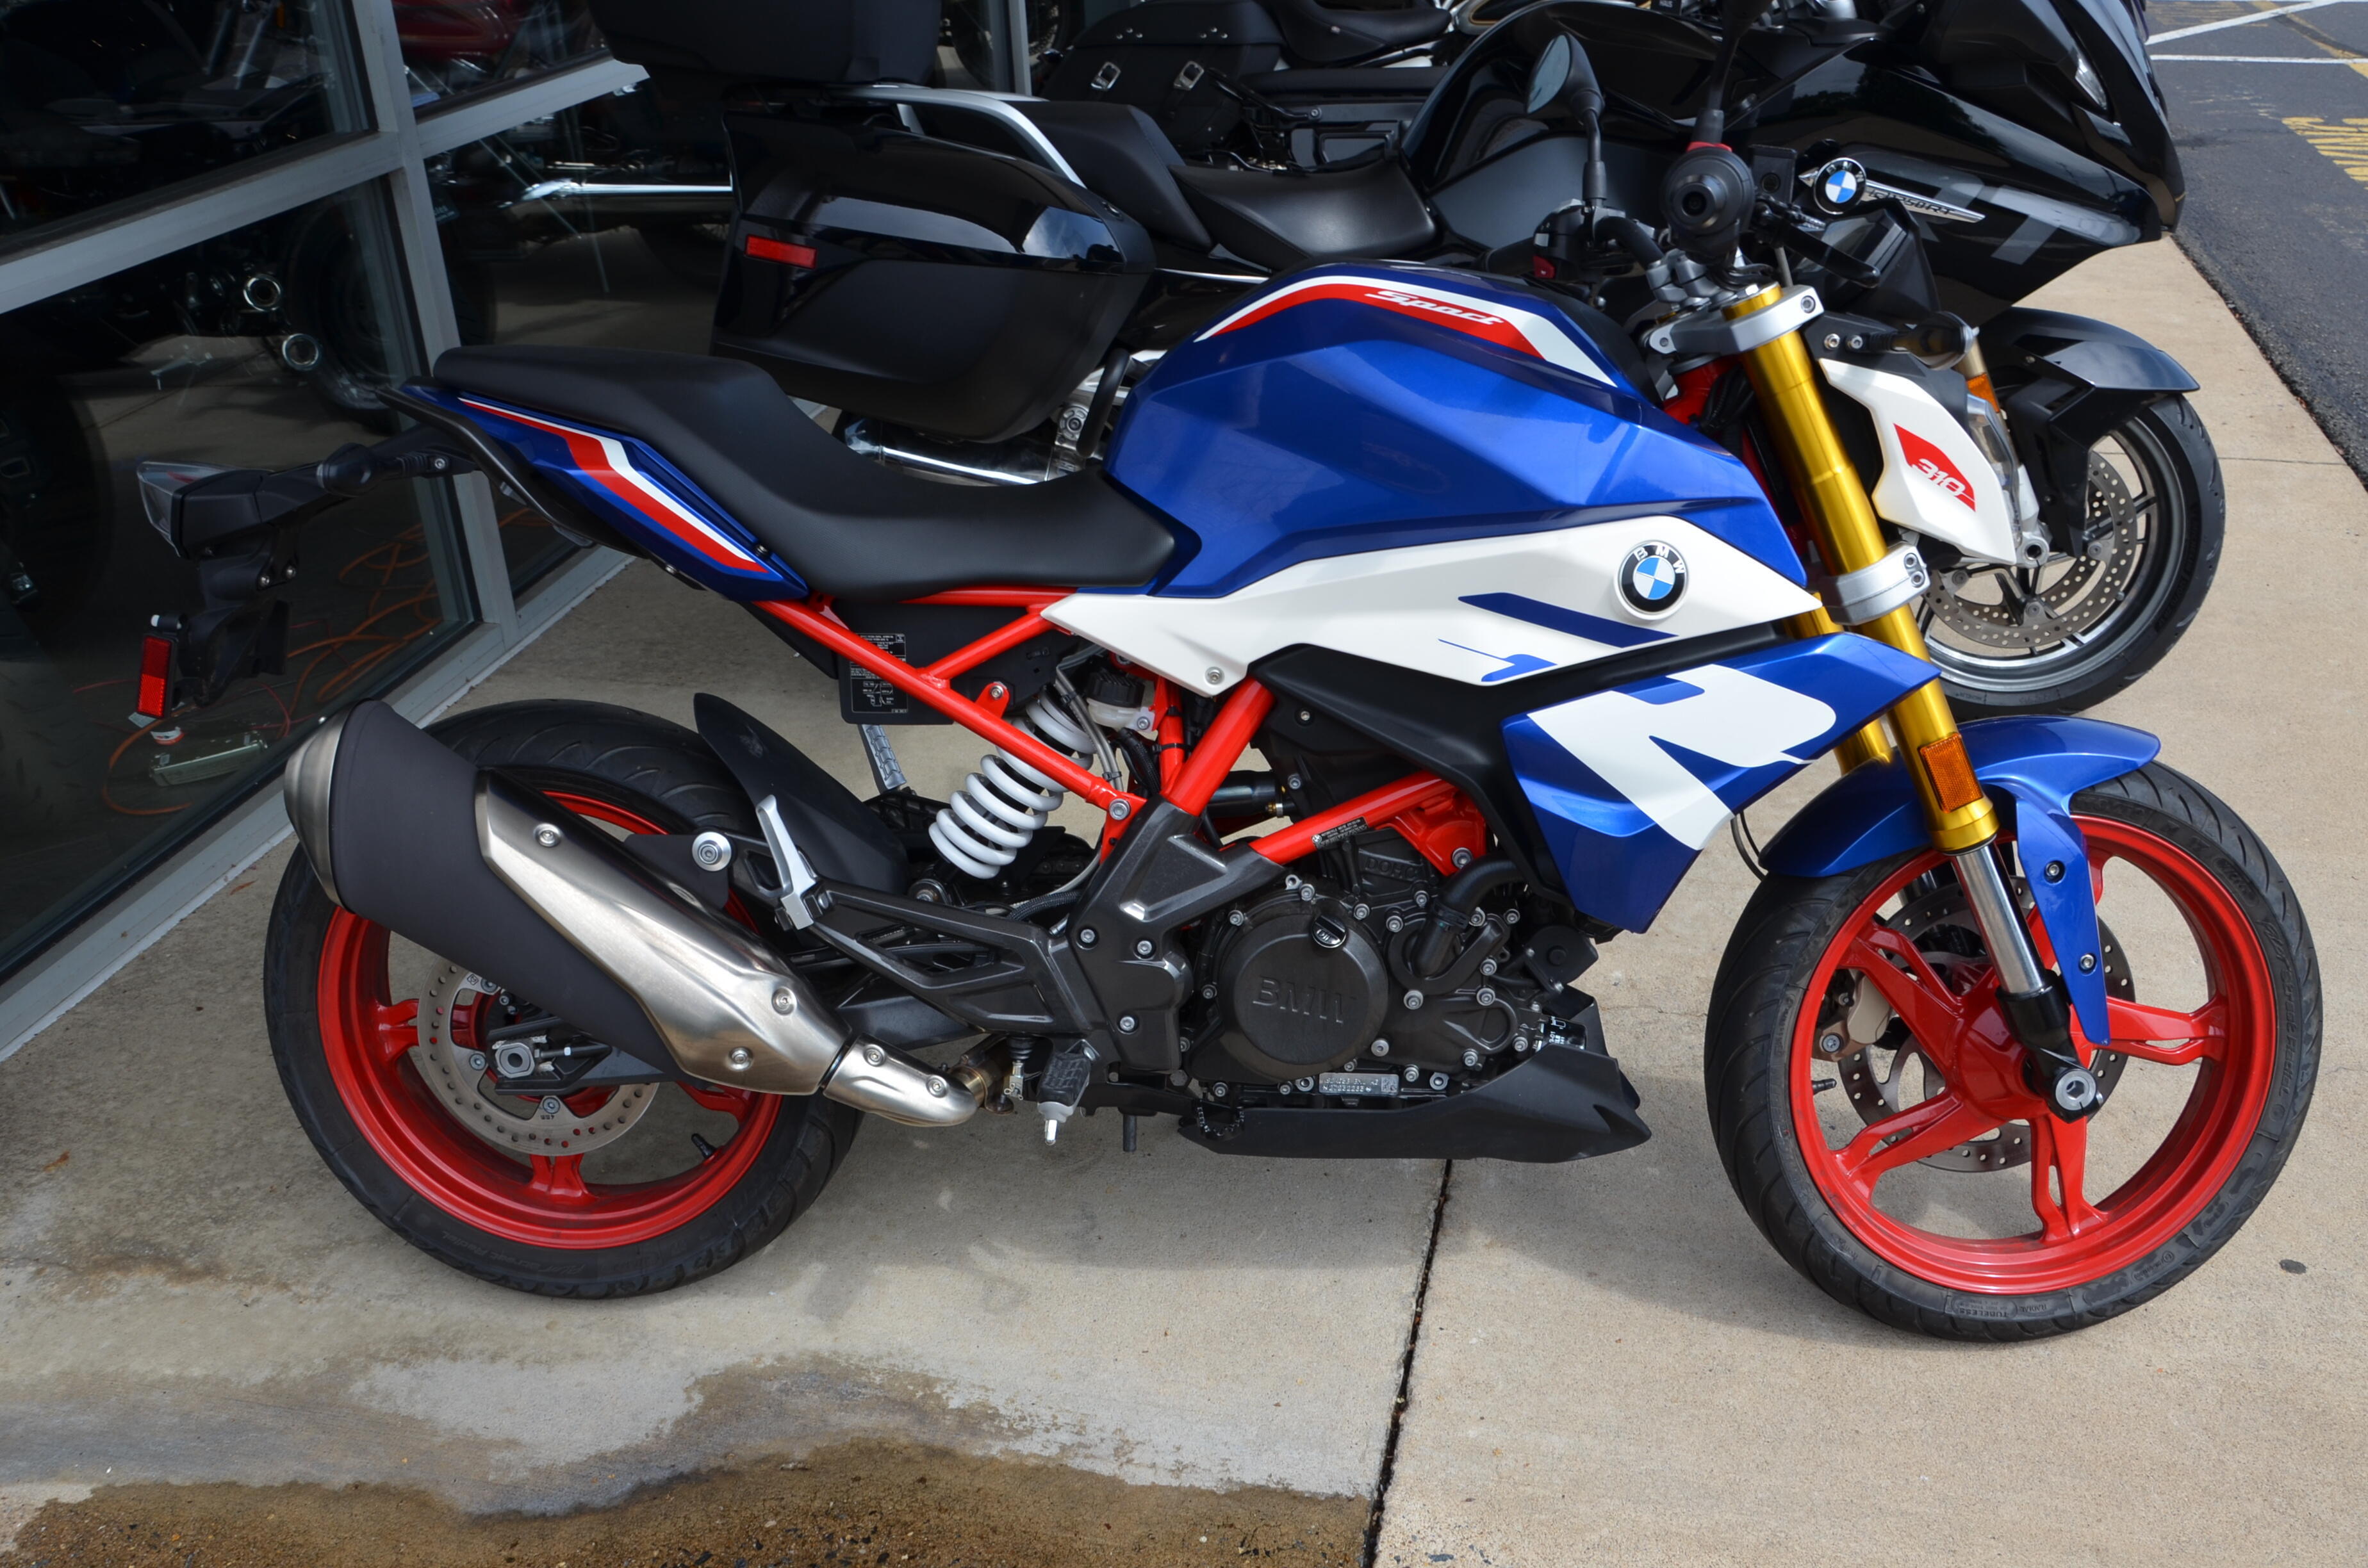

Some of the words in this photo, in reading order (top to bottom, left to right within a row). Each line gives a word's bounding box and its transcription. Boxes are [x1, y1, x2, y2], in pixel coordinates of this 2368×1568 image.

[1364, 290, 1504, 325] Sport
[1911, 458, 1966, 497] 310
[1633, 544, 1686, 575] BMW
[1316, 928, 1332, 942] OIL
[1252, 974, 1357, 1024] BMW
[1959, 1307, 2010, 1318] TUBELESS
